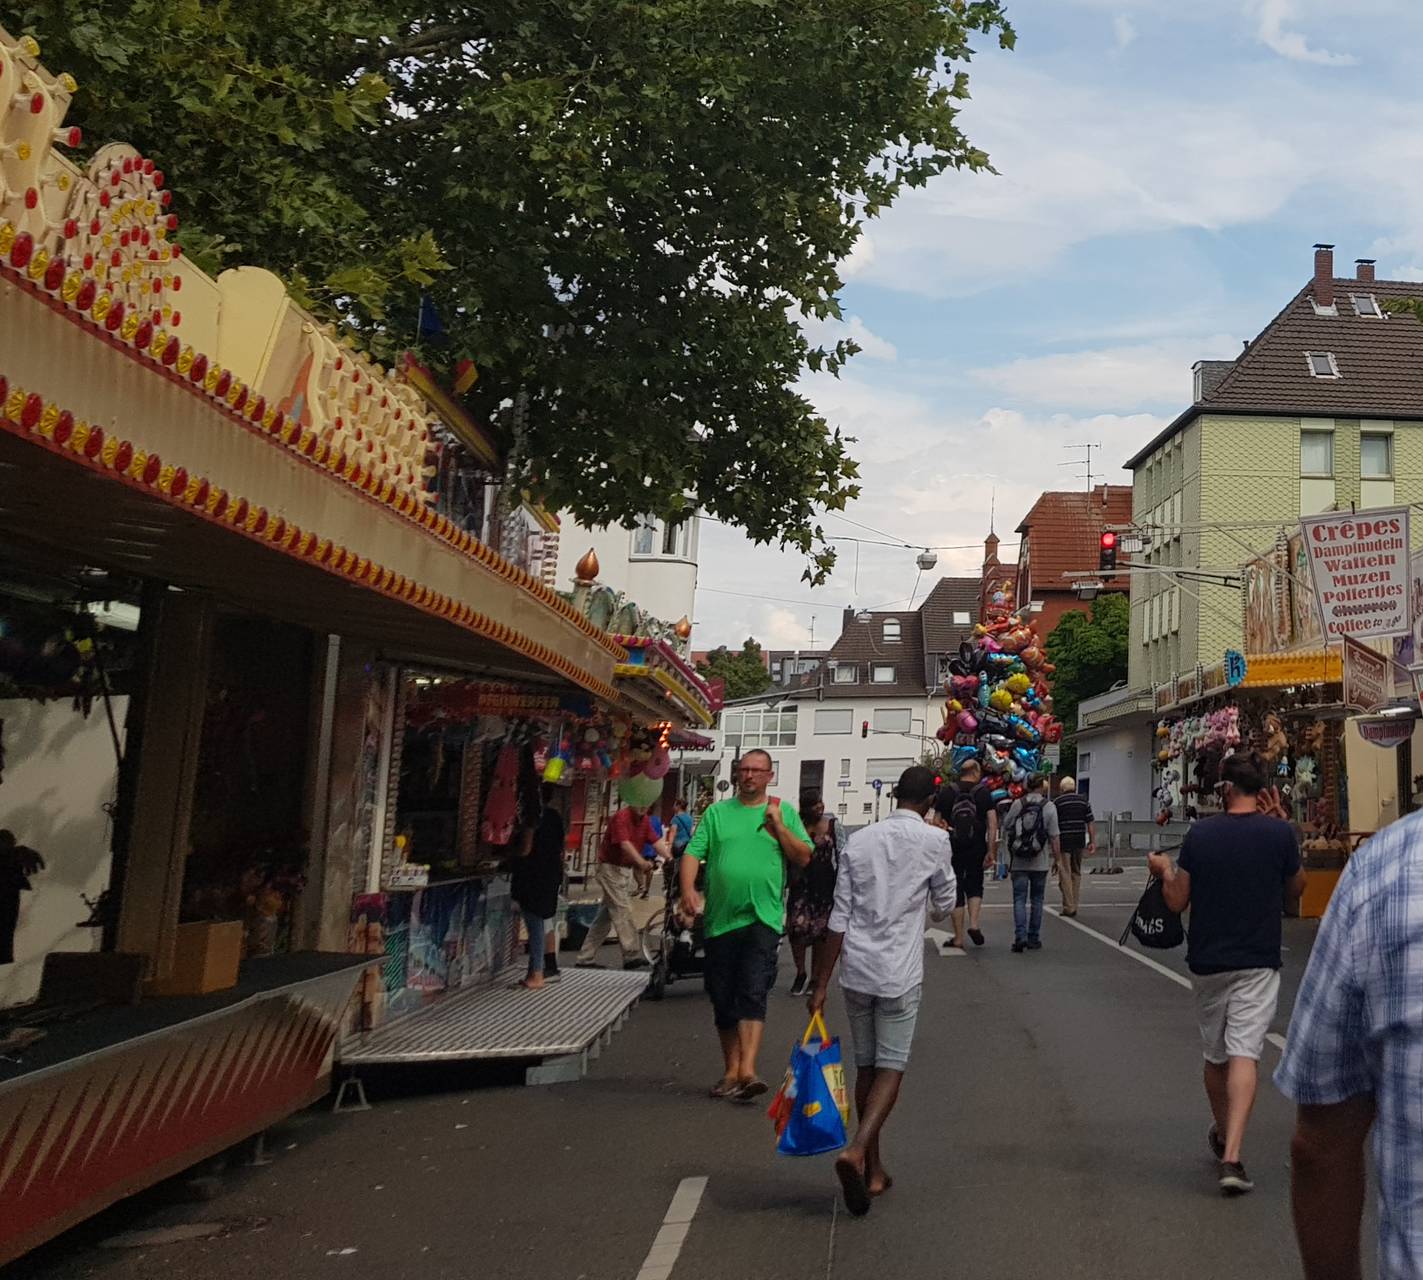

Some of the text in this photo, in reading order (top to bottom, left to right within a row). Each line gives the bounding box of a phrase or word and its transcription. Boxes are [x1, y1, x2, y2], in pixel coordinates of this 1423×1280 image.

[1312, 518, 1400, 543] Crêpes
[1313, 537, 1403, 559] Dampfnudeln
[1324, 554, 1396, 572] Waffeln
[1332, 570, 1391, 588] Muzen
[1323, 583, 1403, 604] Poffertjes
[1328, 618, 1372, 634] Coffee
